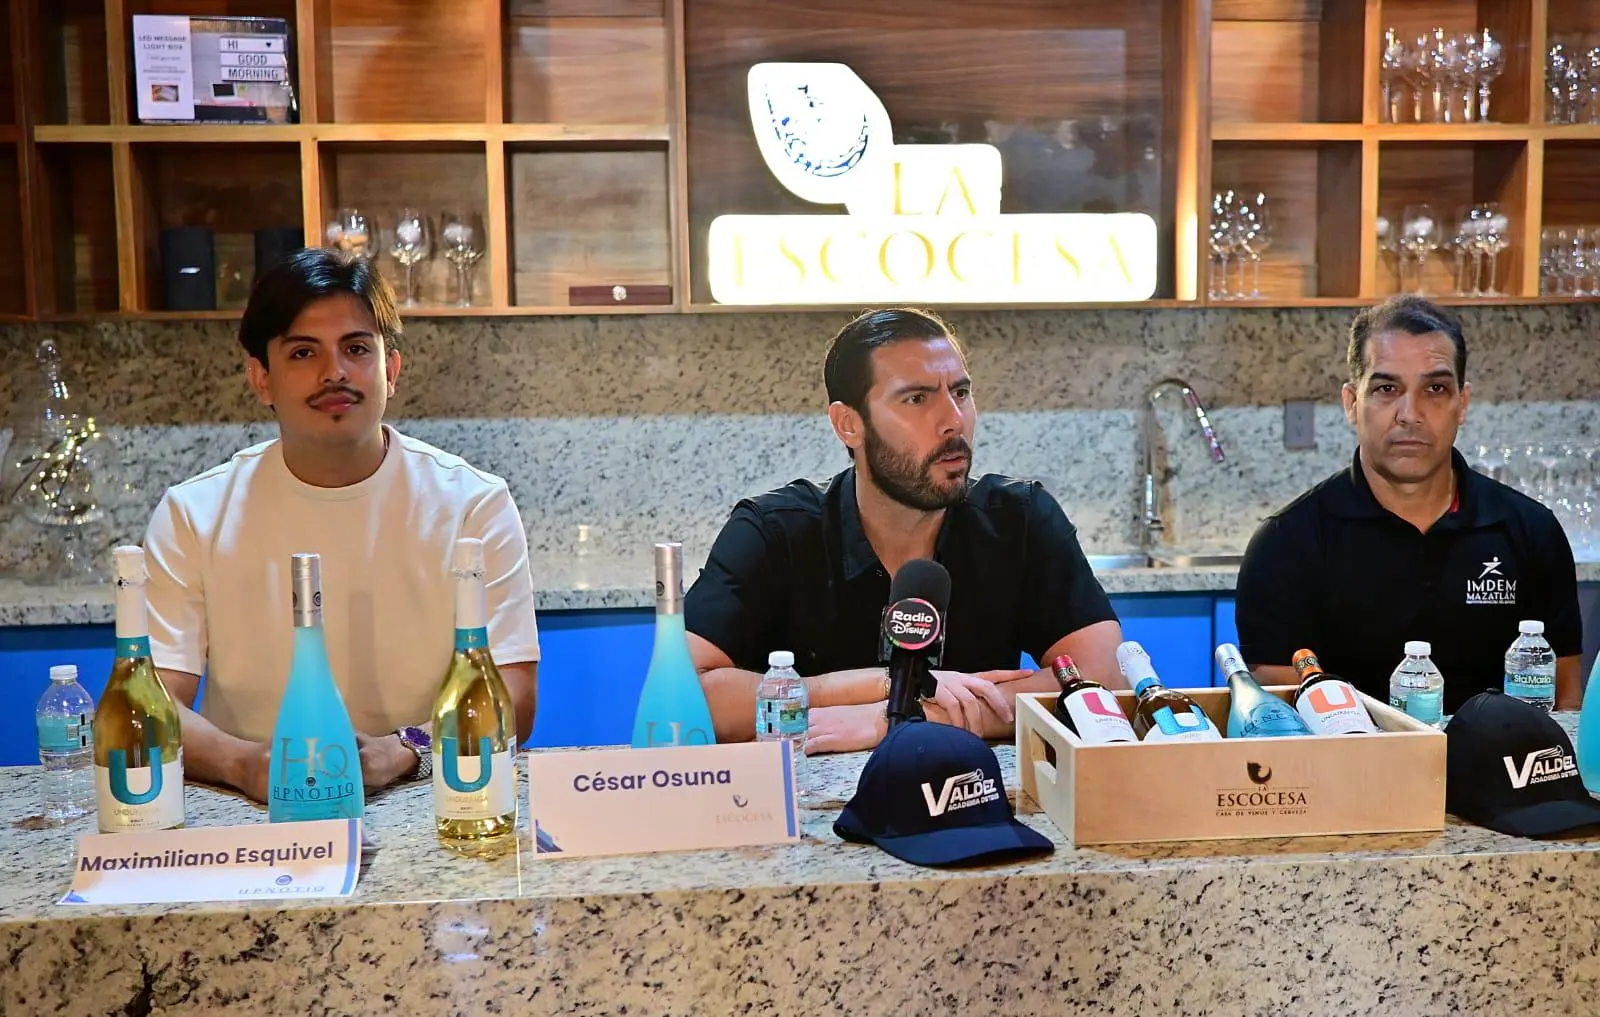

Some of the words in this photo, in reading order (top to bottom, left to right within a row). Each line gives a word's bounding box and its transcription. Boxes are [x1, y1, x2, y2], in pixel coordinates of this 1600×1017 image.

[227, 40, 239, 49] HI
[238, 54, 268, 66] GOOD
[228, 68, 279, 80] MORNING
[892, 162, 977, 216] LA
[1467, 579, 1517, 592] IMDEM
[892, 610, 934, 623] Radio
[890, 620, 931, 639] Disney
[441, 735, 493, 793] U
[108, 745, 164, 806] U
[573, 771, 646, 792] César
[652, 768, 732, 788] Osuna
[273, 782, 355, 800] HPNOTIQ
[1217, 792, 1307, 807] ESCOCESA
[80, 849, 230, 872] Maximiliano
[235, 841, 333, 866] Esquivel
